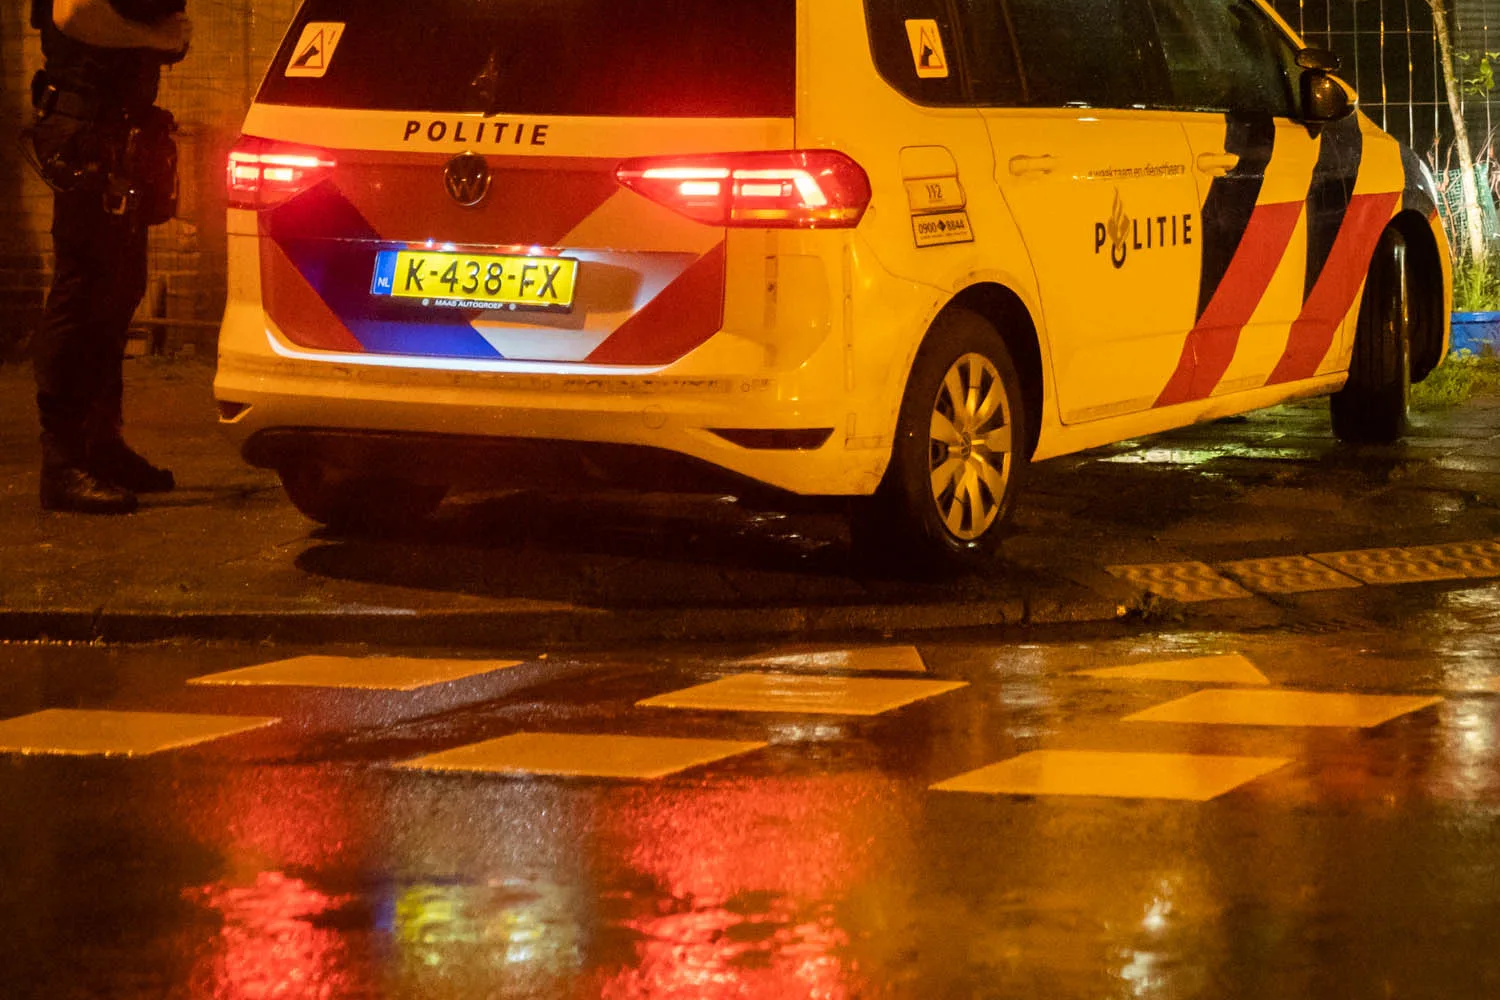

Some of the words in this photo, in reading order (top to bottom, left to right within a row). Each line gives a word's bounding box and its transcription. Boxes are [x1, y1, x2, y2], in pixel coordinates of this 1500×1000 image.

[403, 120, 549, 146] POLITIE
[926, 184, 942, 199] 112
[918, 222, 937, 234] 0900
[1095, 212, 1191, 269] POLITIE
[377, 277, 391, 289] NL
[404, 258, 561, 299] K-438-FX
